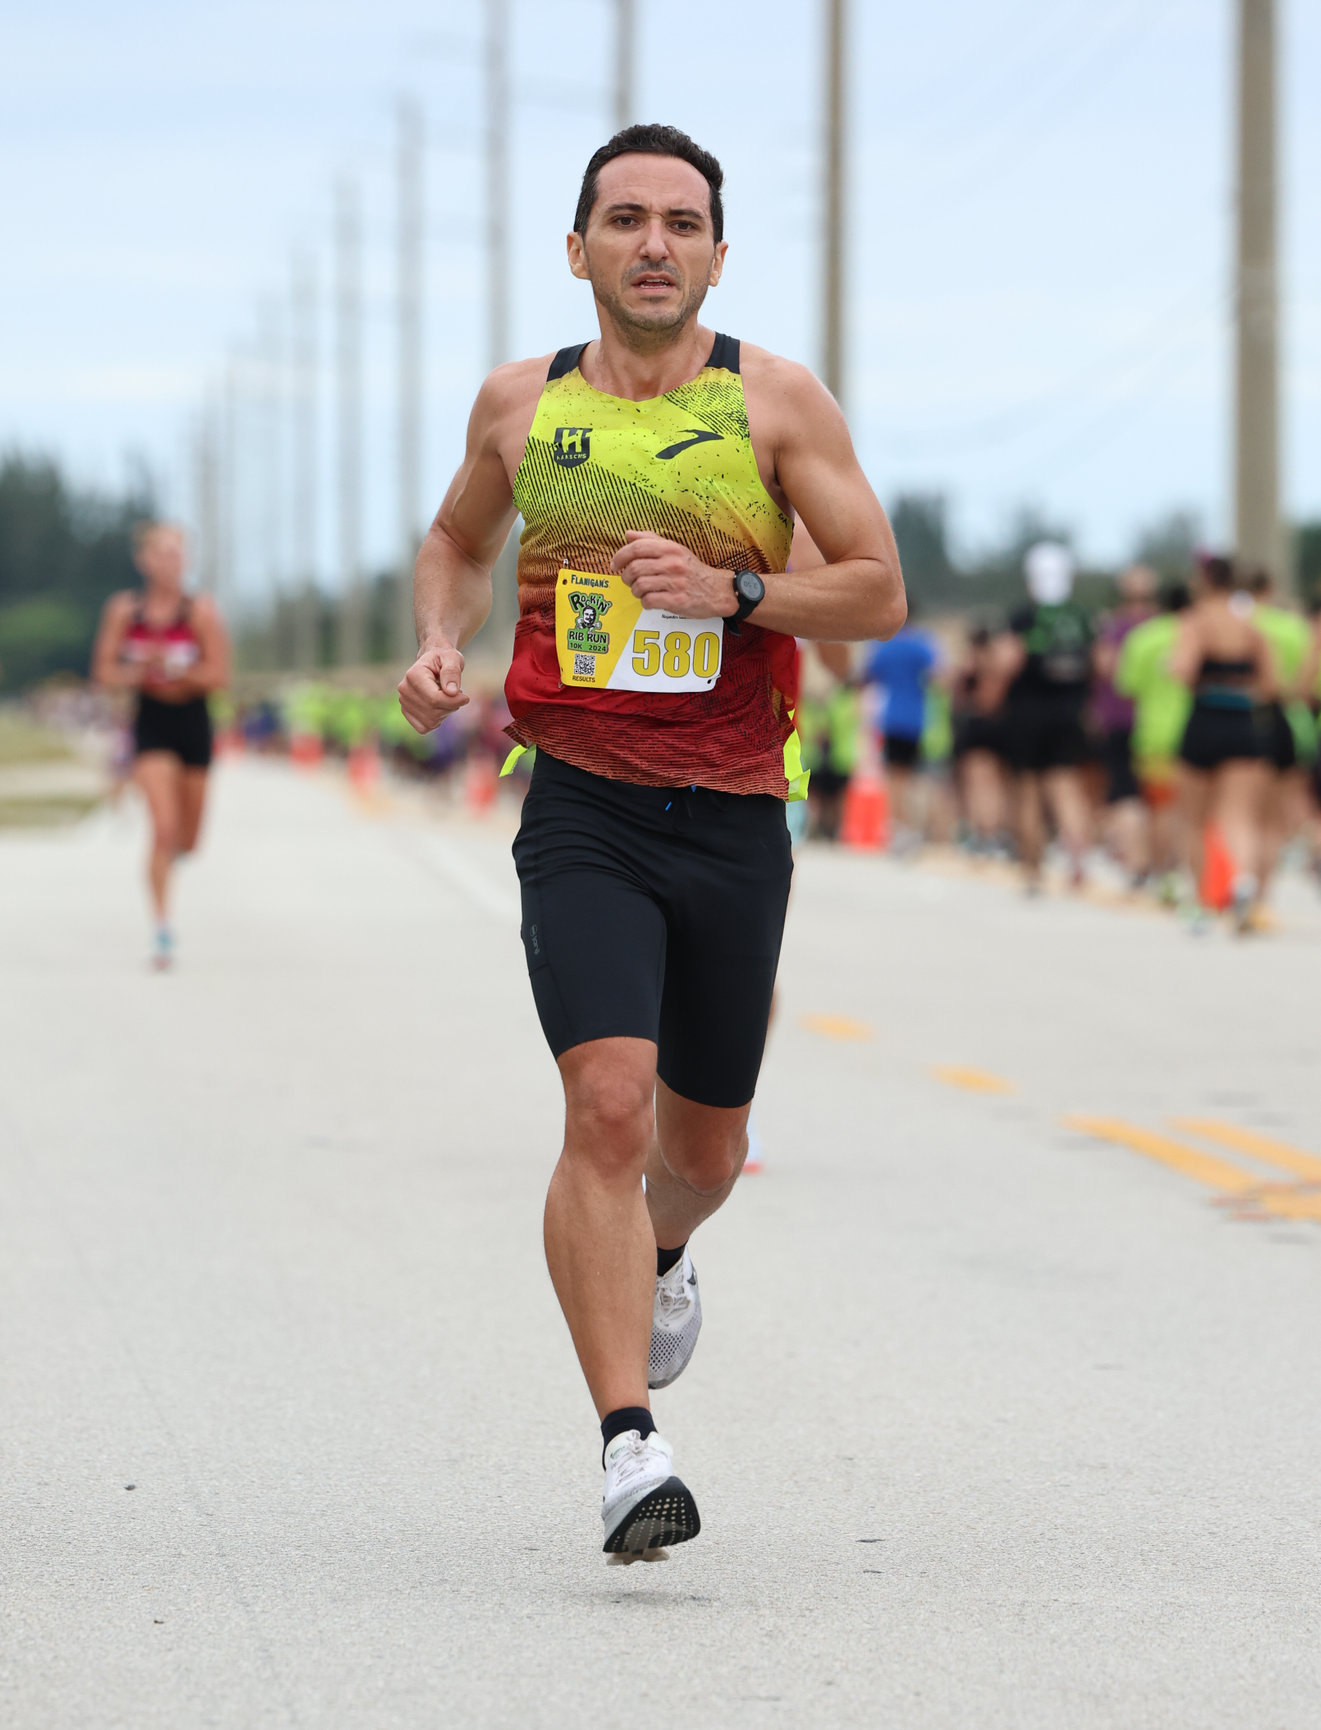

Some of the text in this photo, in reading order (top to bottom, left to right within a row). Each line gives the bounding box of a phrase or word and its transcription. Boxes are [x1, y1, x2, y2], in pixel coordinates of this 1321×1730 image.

[571, 574, 609, 588] FLANIGAN'S
[569, 631, 607, 643] RIB RUN
[588, 644, 606, 652] 2024
[632, 629, 720, 679] 580
[572, 675, 596, 683] RESULTS
